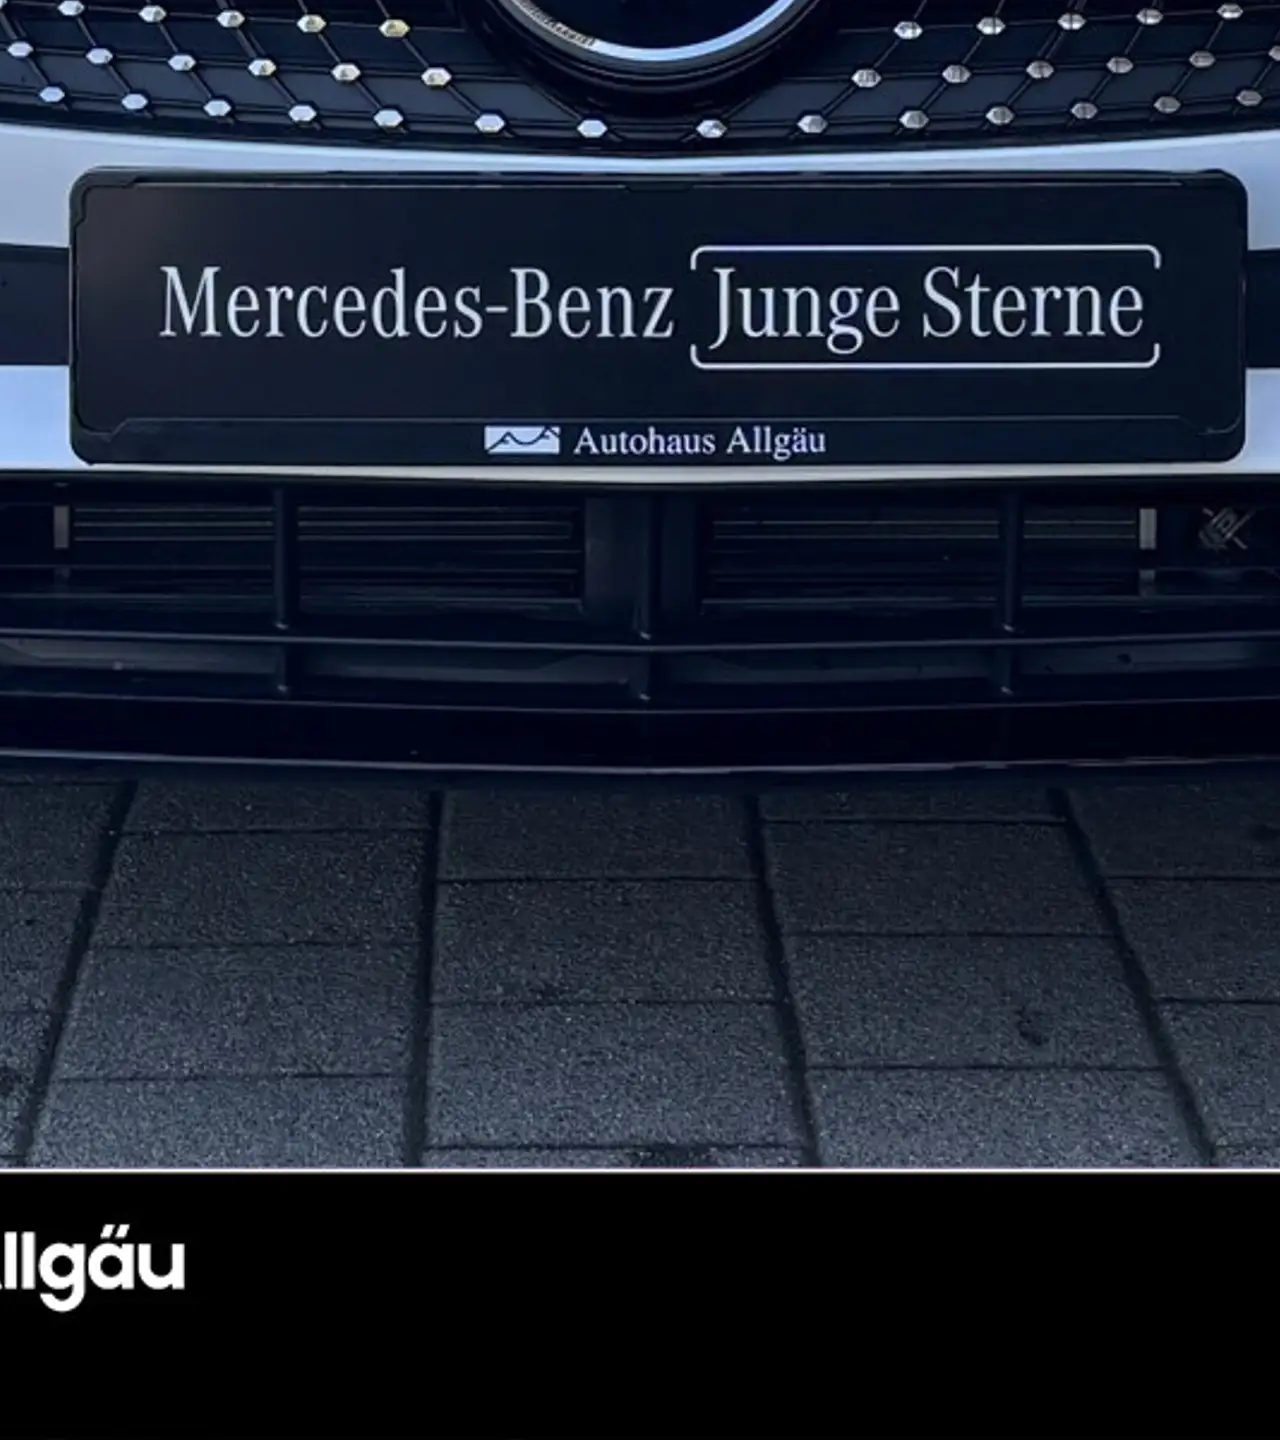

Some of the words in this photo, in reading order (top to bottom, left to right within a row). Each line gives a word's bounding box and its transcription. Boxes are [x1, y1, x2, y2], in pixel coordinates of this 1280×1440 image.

[159, 265, 673, 339] Mercedes-Benz
[708, 267, 900, 355] Junge
[923, 266, 1143, 338] Sterne
[573, 426, 716, 455] Autohaus
[726, 425, 826, 462] Allgäu
